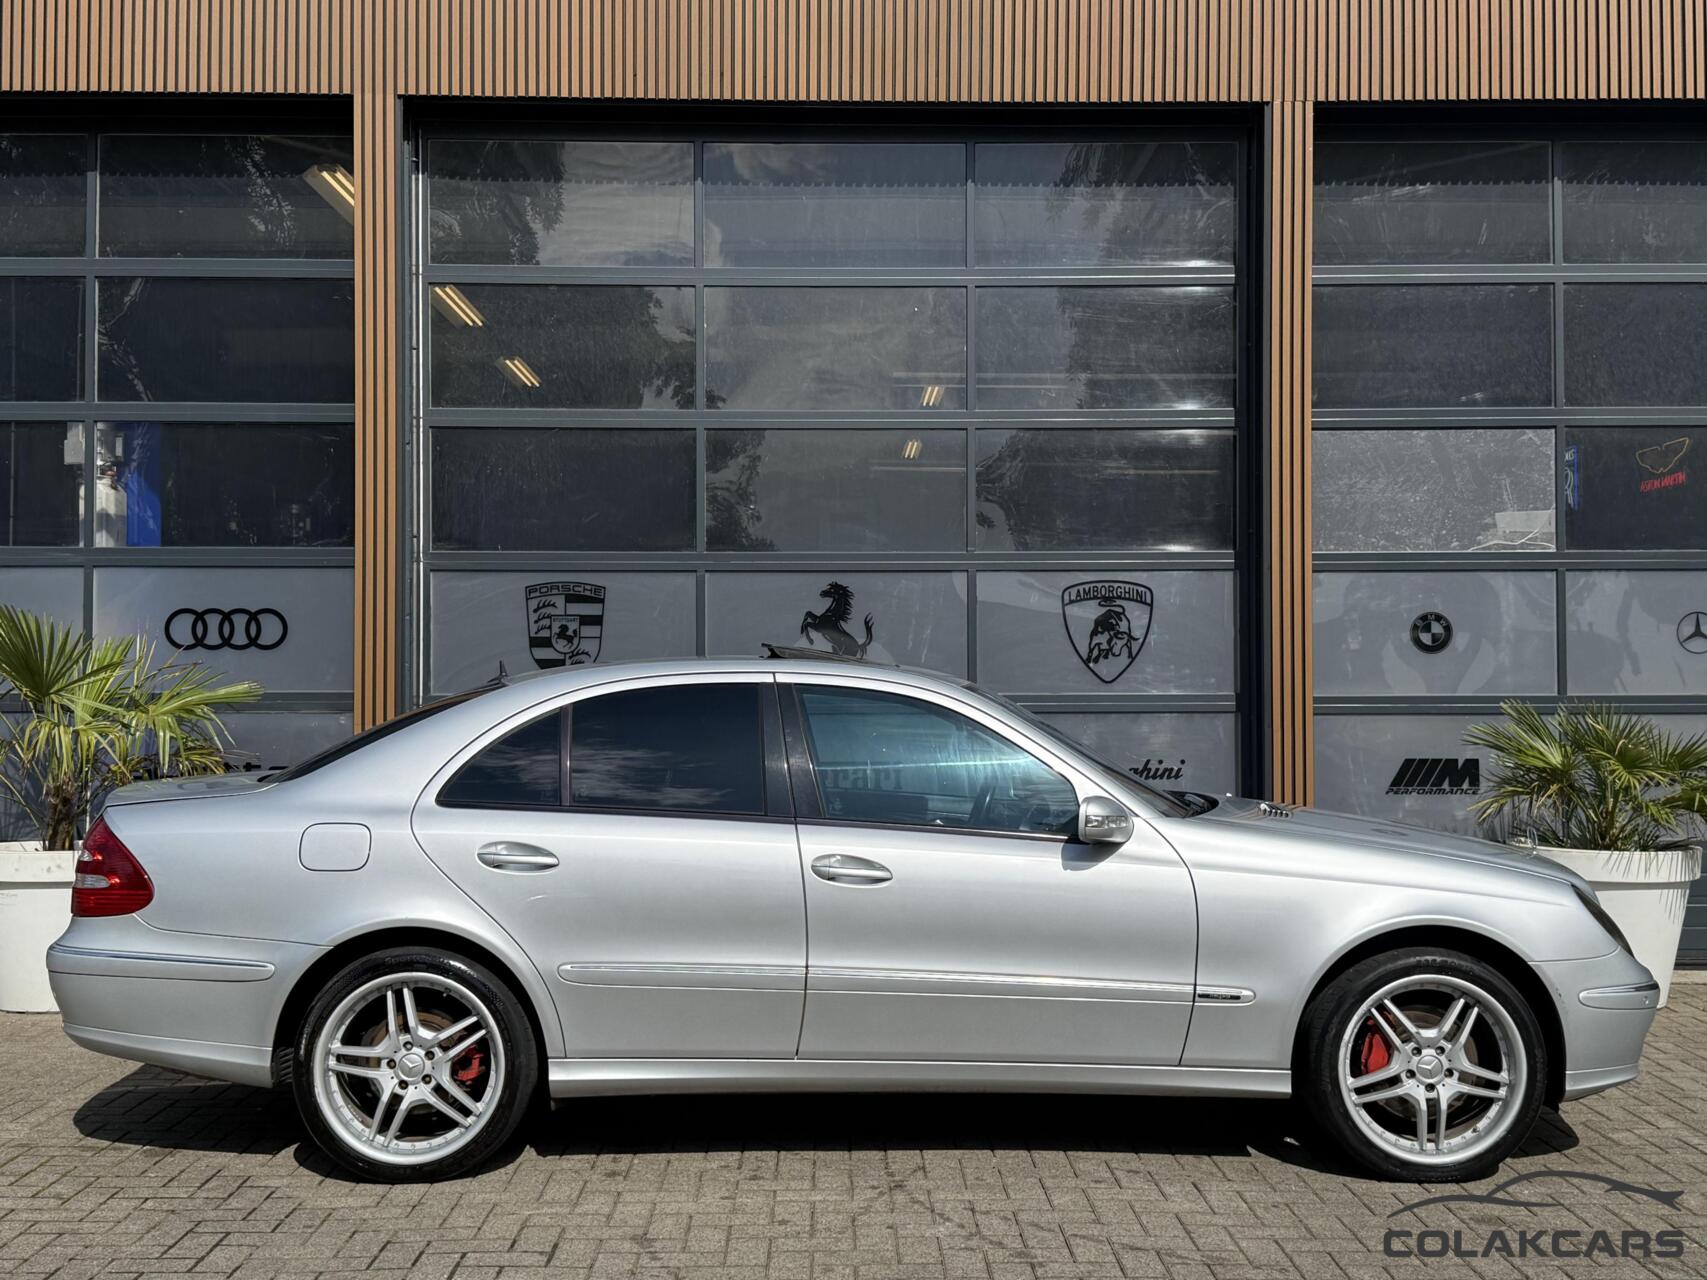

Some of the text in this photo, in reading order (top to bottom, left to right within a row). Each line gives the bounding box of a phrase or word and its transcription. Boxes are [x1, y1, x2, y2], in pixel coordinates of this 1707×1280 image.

[528, 584, 603, 597] PORSCHE
[1068, 585, 1147, 603] LAMBORGHINI
[1414, 613, 1449, 627] BMW
[1385, 787, 1481, 796] PERFORMANCE
